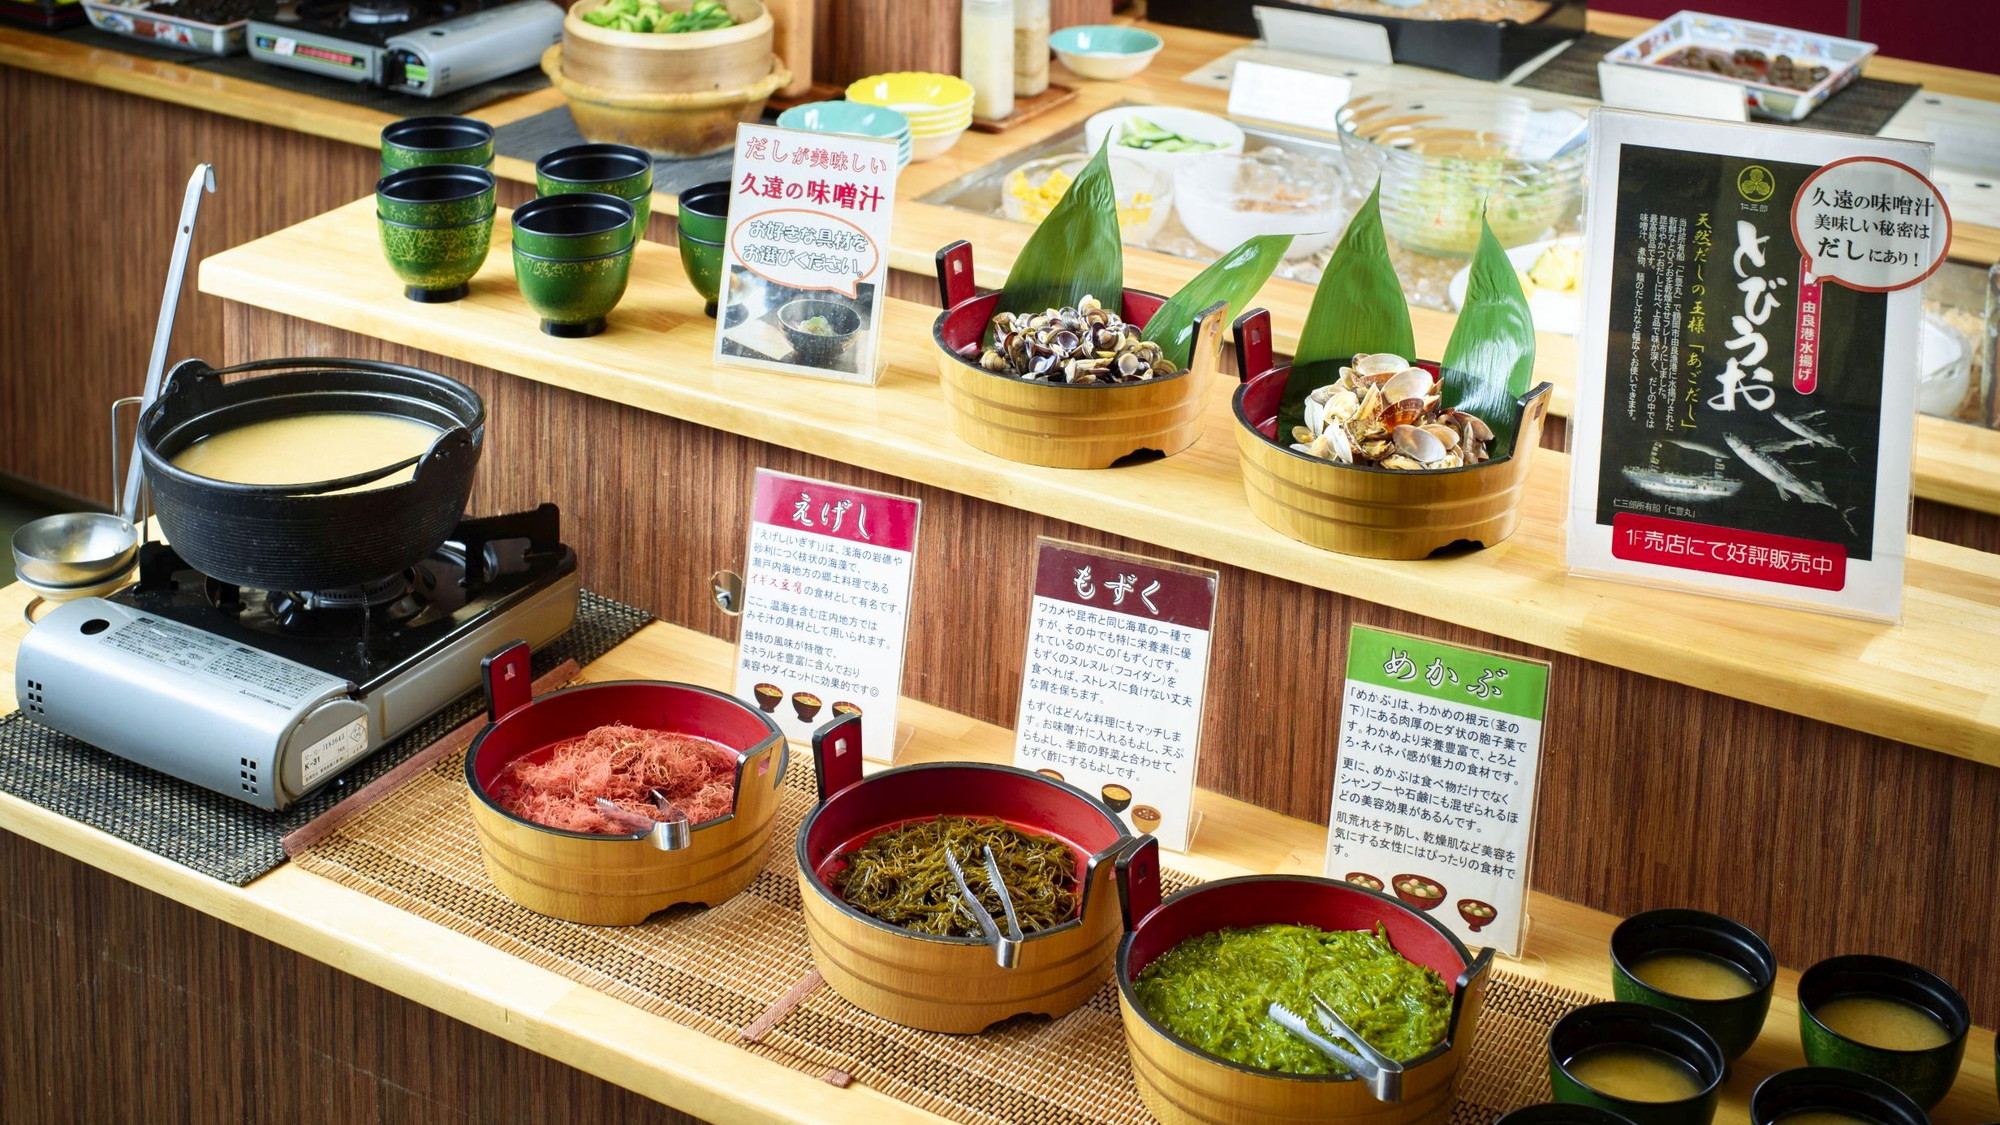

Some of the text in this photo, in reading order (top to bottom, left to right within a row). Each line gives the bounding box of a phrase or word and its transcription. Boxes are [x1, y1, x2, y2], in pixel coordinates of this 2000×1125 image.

[745, 136, 887, 175] だしが美味しい
[738, 173, 885, 212] 久遠の味噌汁
[1812, 187, 1935, 217] 久遠の味噌汁
[748, 220, 868, 252] お好きな具材を
[1814, 213, 1930, 239] 美味しい秘密は
[742, 244, 864, 278] お選びください。
[1681, 213, 1712, 428] 天然だしの王様「あごだし」
[1707, 219, 1788, 412] とびうお
[1797, 259, 1818, 381] ・由良港水揚げ
[792, 492, 870, 540] えげし
[1626, 529, 1833, 576] 1F売店にて好評販売中
[1073, 565, 1161, 615] もずく
[746, 610, 890, 650] みそ汁の具材として用いられます。
[1037, 617, 1192, 660] すが、その中でも特に栄養素に優
[1038, 602, 1192, 643] ワカメや昆布と同じ海草の一種で
[743, 644, 860, 678] ミネラルを豊富に含んでおり
[1035, 632, 1179, 673] れているのがこの「もずく」です。
[1382, 646, 1510, 699] めかぶ
[1029, 677, 1104, 705] な胃を保ちます。
[1031, 662, 1193, 708] 食べれば、ストレスに負けない丈夫
[1027, 698, 1182, 742] もずくはどんな料理にもマッチしま
[1022, 745, 1140, 782] もずく酢にするもよしです。
[1023, 730, 1177, 774] らもよし、季節の野菜と合わせて、
[1347, 720, 1517, 768] す。わかめより栄養豊富で、とろと
[1342, 756, 1509, 805] 更に、めかぶは食べ物だけでなく
[1338, 789, 1482, 833] どの美容効果があるんです。
[1333, 843, 1349, 858] す。
[1336, 811, 1516, 864] 肌荒れを予防し、乾燥肌など美容を
